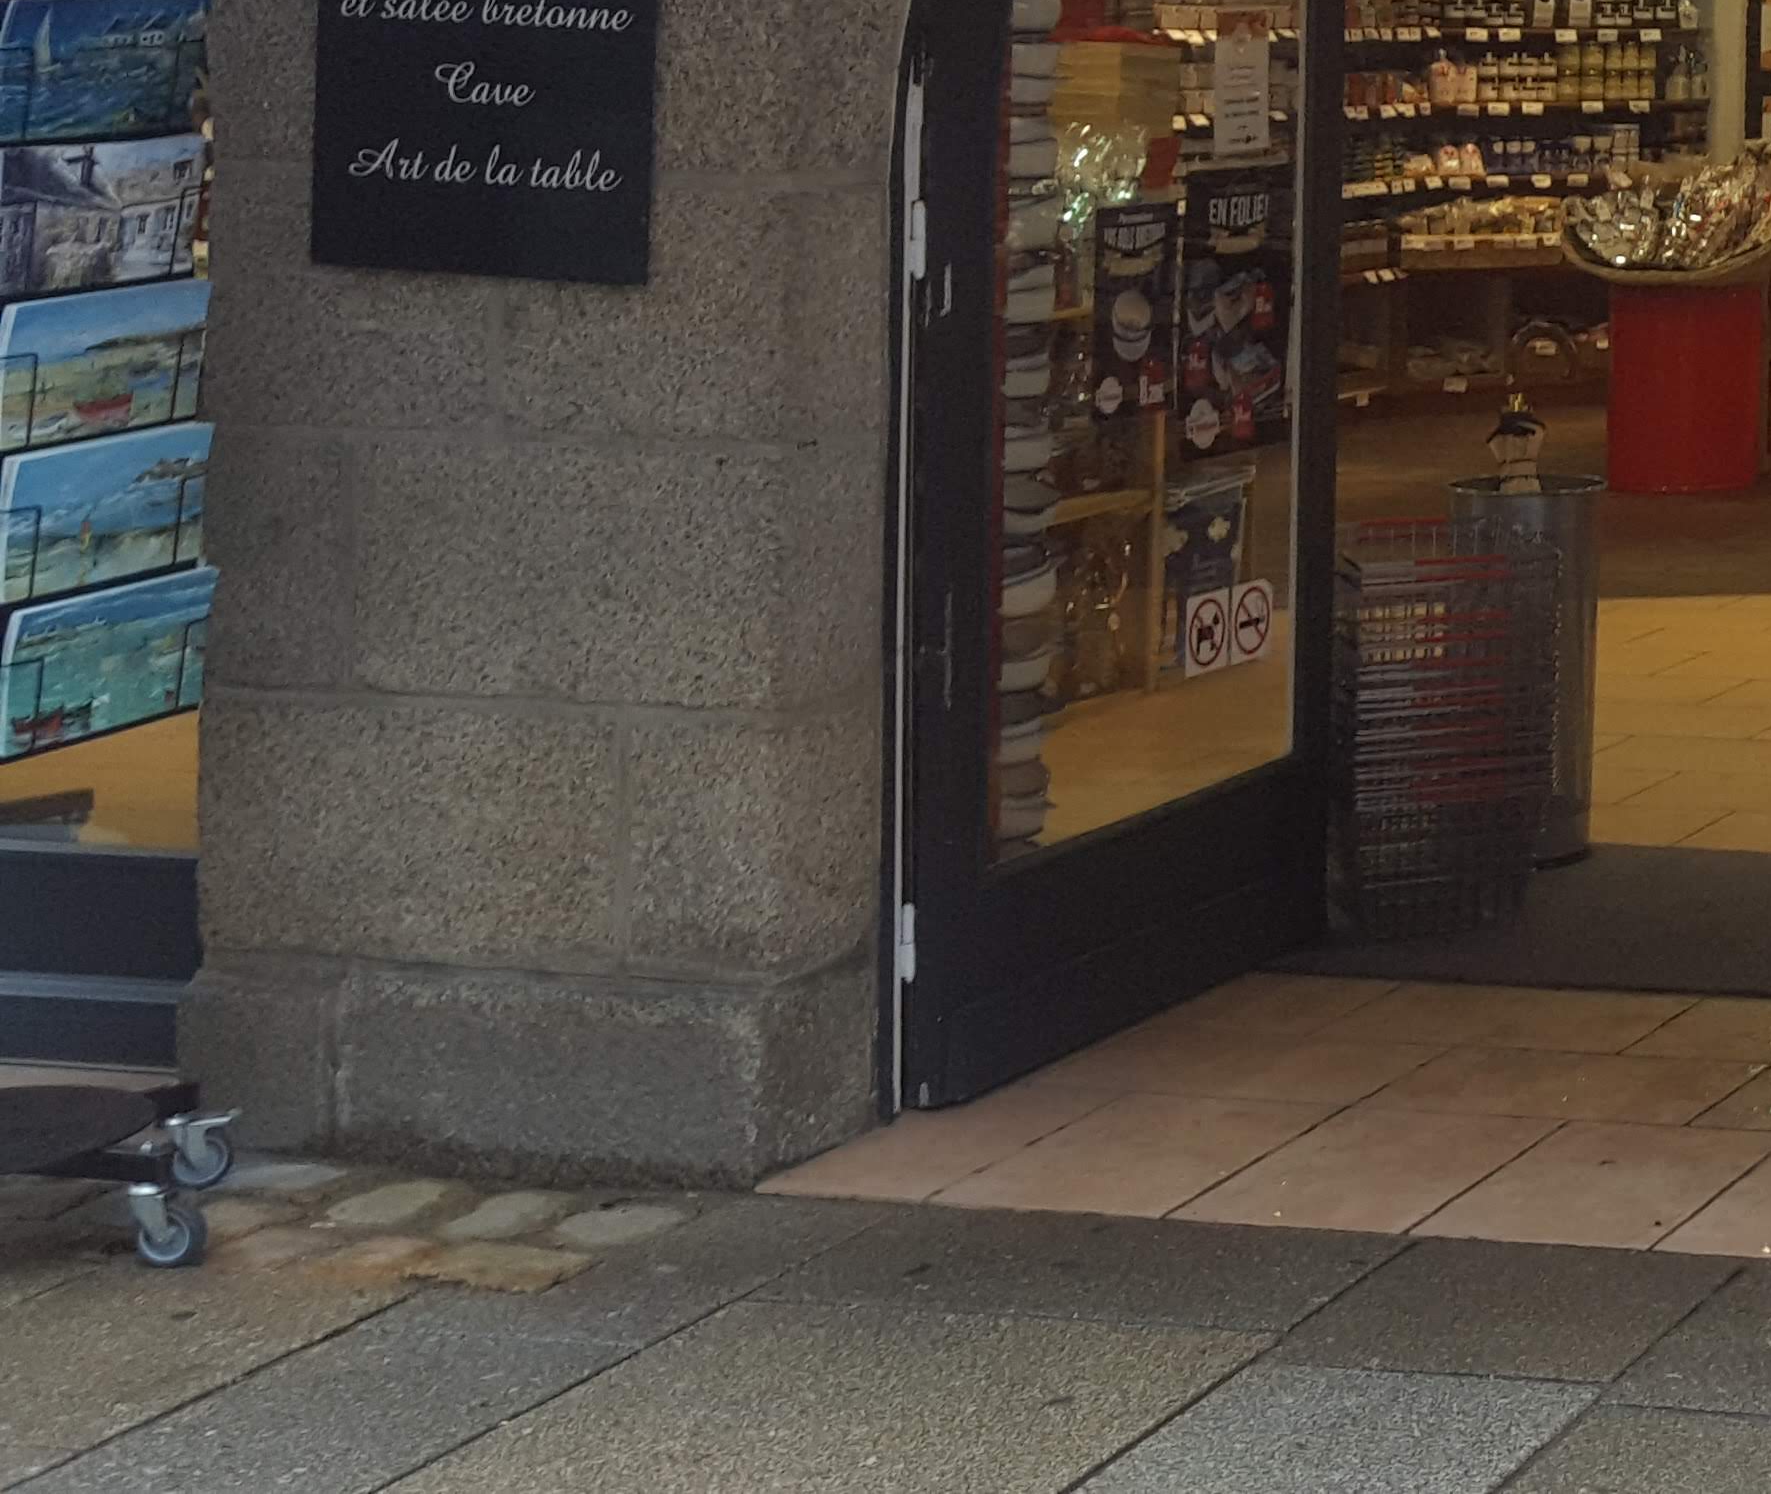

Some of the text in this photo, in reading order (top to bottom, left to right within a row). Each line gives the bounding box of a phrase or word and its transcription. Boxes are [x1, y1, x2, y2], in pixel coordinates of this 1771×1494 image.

[434, 61, 536, 107] Cave
[348, 137, 623, 192] Art de la table
[1209, 194, 1269, 227] EN FOLIE!
